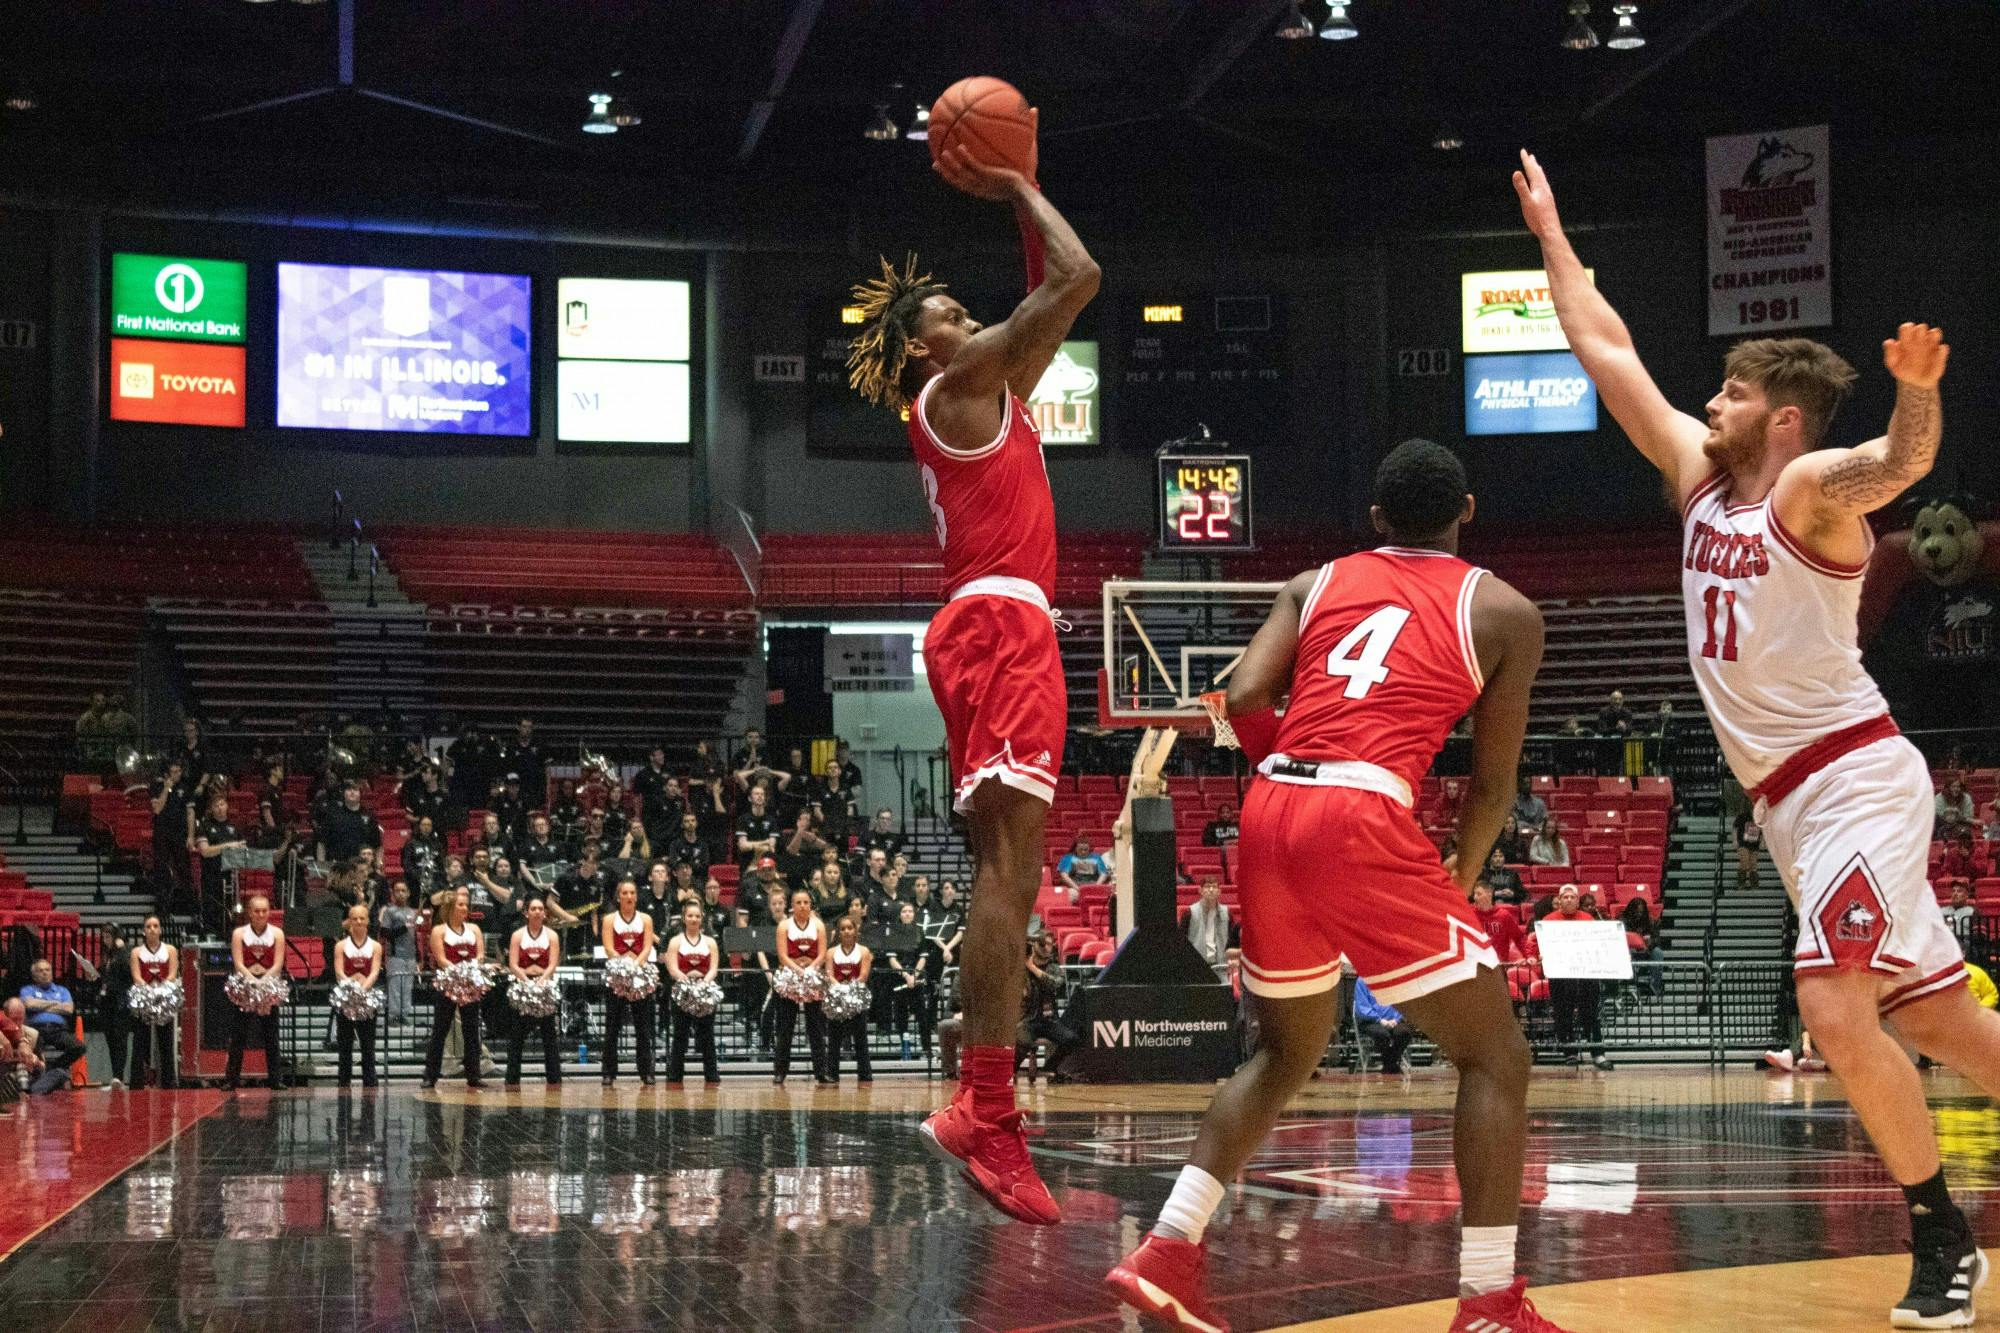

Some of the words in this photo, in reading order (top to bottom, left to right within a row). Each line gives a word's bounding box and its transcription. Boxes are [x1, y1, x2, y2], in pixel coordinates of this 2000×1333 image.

[1712, 264, 1825, 290] CHAMPIONS
[1144, 305, 1183, 322] MIAMI
[1739, 297, 1800, 325] 1981
[117, 314, 142, 329] First
[145, 316, 204, 333] National
[207, 320, 241, 336] Bank
[344, 354, 373, 380] IN
[381, 356, 506, 386] ILLINOIS.
[762, 361, 798, 376] EAST
[160, 374, 237, 395] TOYOTA
[1480, 398, 1530, 410] PHYSICAL
[1533, 395, 1581, 408] THERAPY
[1178, 467, 1239, 492] 14:42
[1180, 495, 1231, 538] 22
[1685, 520, 1770, 579] HUSKIES
[1702, 585, 1738, 662] 11
[1326, 604, 1413, 700] 4
[1134, 1019, 1227, 1032] Northwestern
[1134, 1035, 1193, 1047] Medicine
